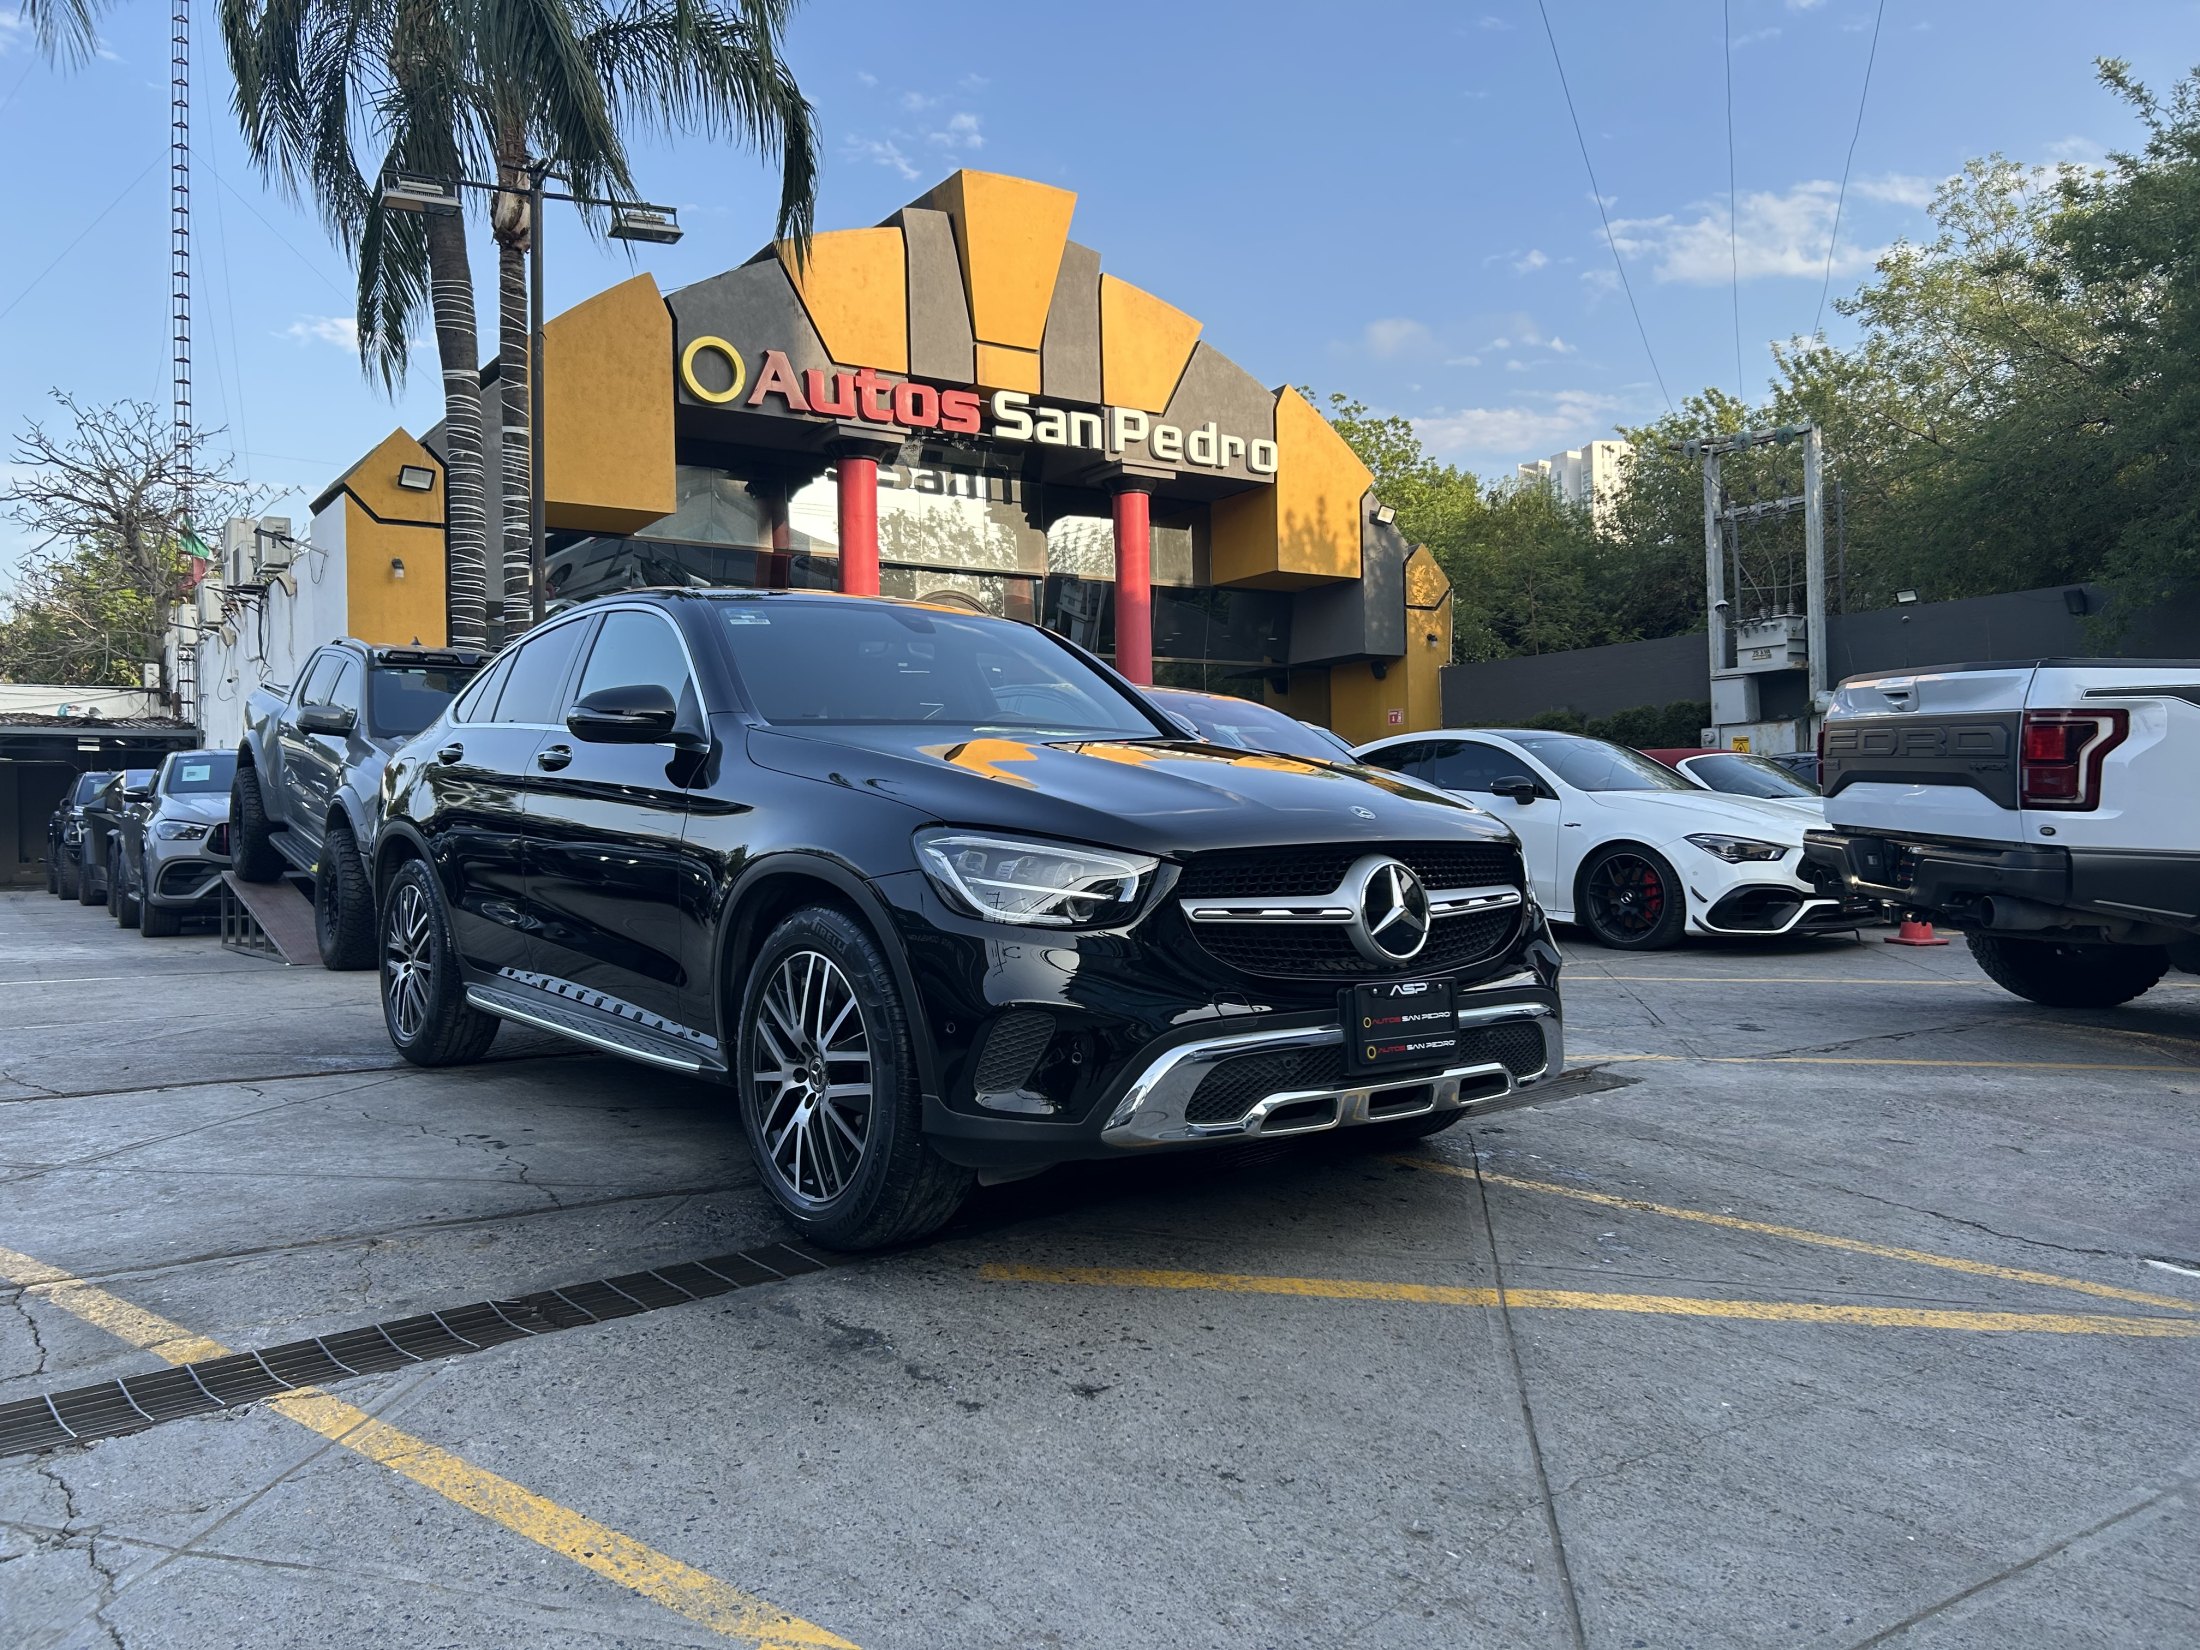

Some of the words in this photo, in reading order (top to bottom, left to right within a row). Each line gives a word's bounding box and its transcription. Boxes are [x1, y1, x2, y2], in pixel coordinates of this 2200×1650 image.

[747, 349, 981, 435] Autos
[1825, 722, 2011, 759] FORD
[811, 916, 849, 955] PIRELLI
[1390, 982, 1428, 996] ASP
[1372, 1017, 1401, 1025] AUTOS
[1421, 1011, 1451, 1020] PEDRO
[1378, 1045, 1405, 1053] AUTOS
[1407, 1043, 1425, 1051] SAN
[1426, 1040, 1455, 1048] PEDRO
